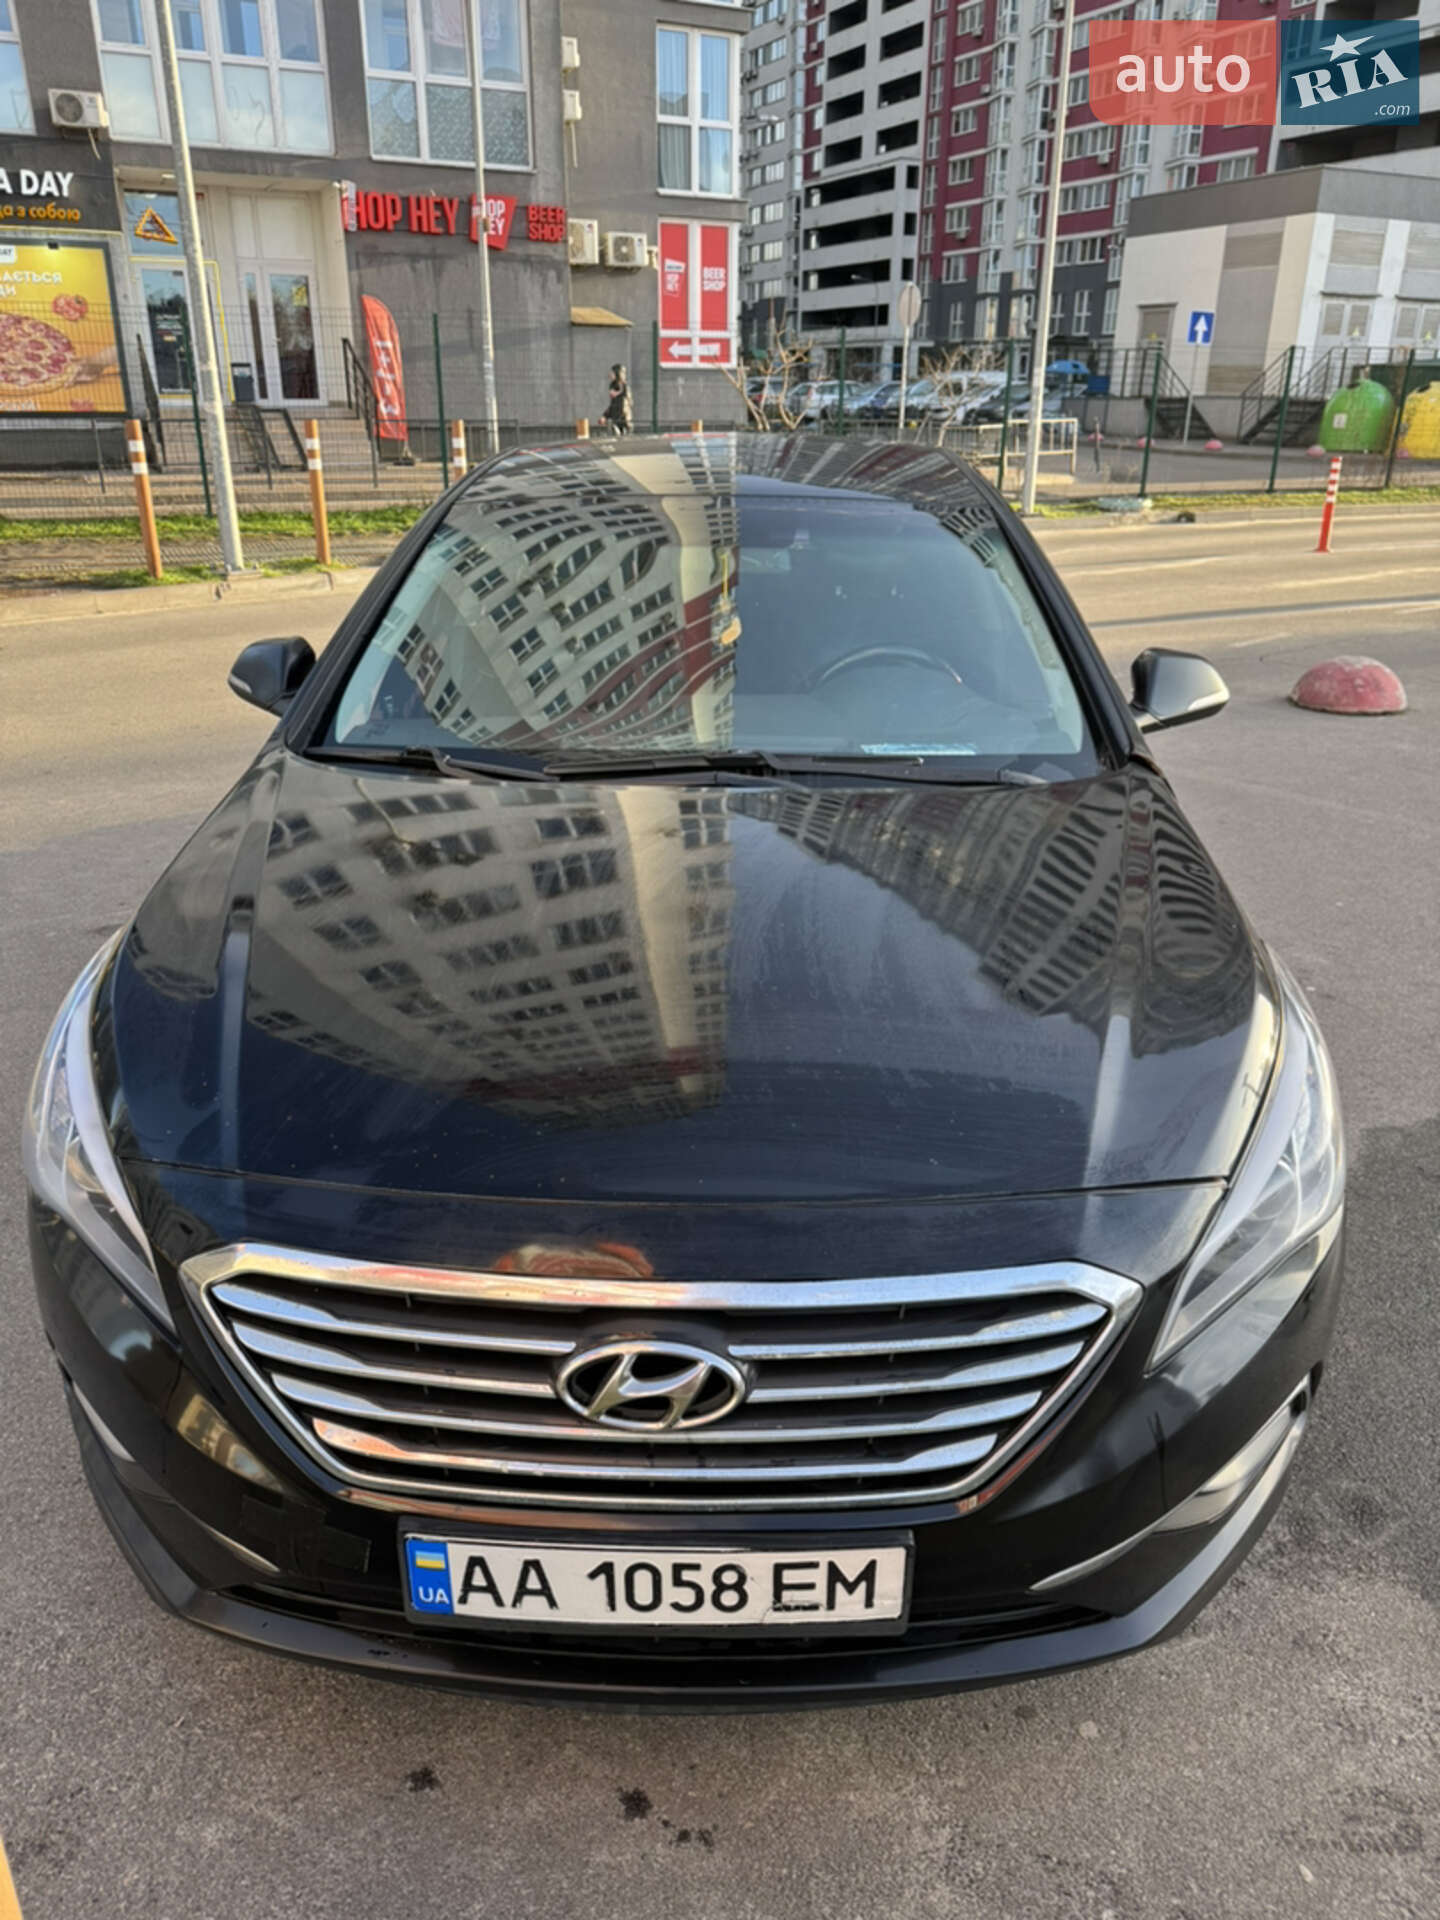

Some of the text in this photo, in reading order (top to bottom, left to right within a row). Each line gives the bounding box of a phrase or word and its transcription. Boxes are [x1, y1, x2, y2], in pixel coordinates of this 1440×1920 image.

[20, 169, 74, 197] DAY
[28, 202, 81, 223] собою
[409, 193, 459, 235] HEY
[484, 198, 506, 217] OP
[528, 204, 566, 223] BEER
[487, 217, 506, 236] EY
[528, 222, 566, 242] SHOP
[457, 1556, 877, 1613] AA 1058 EM
[418, 1586, 449, 1604] UA
